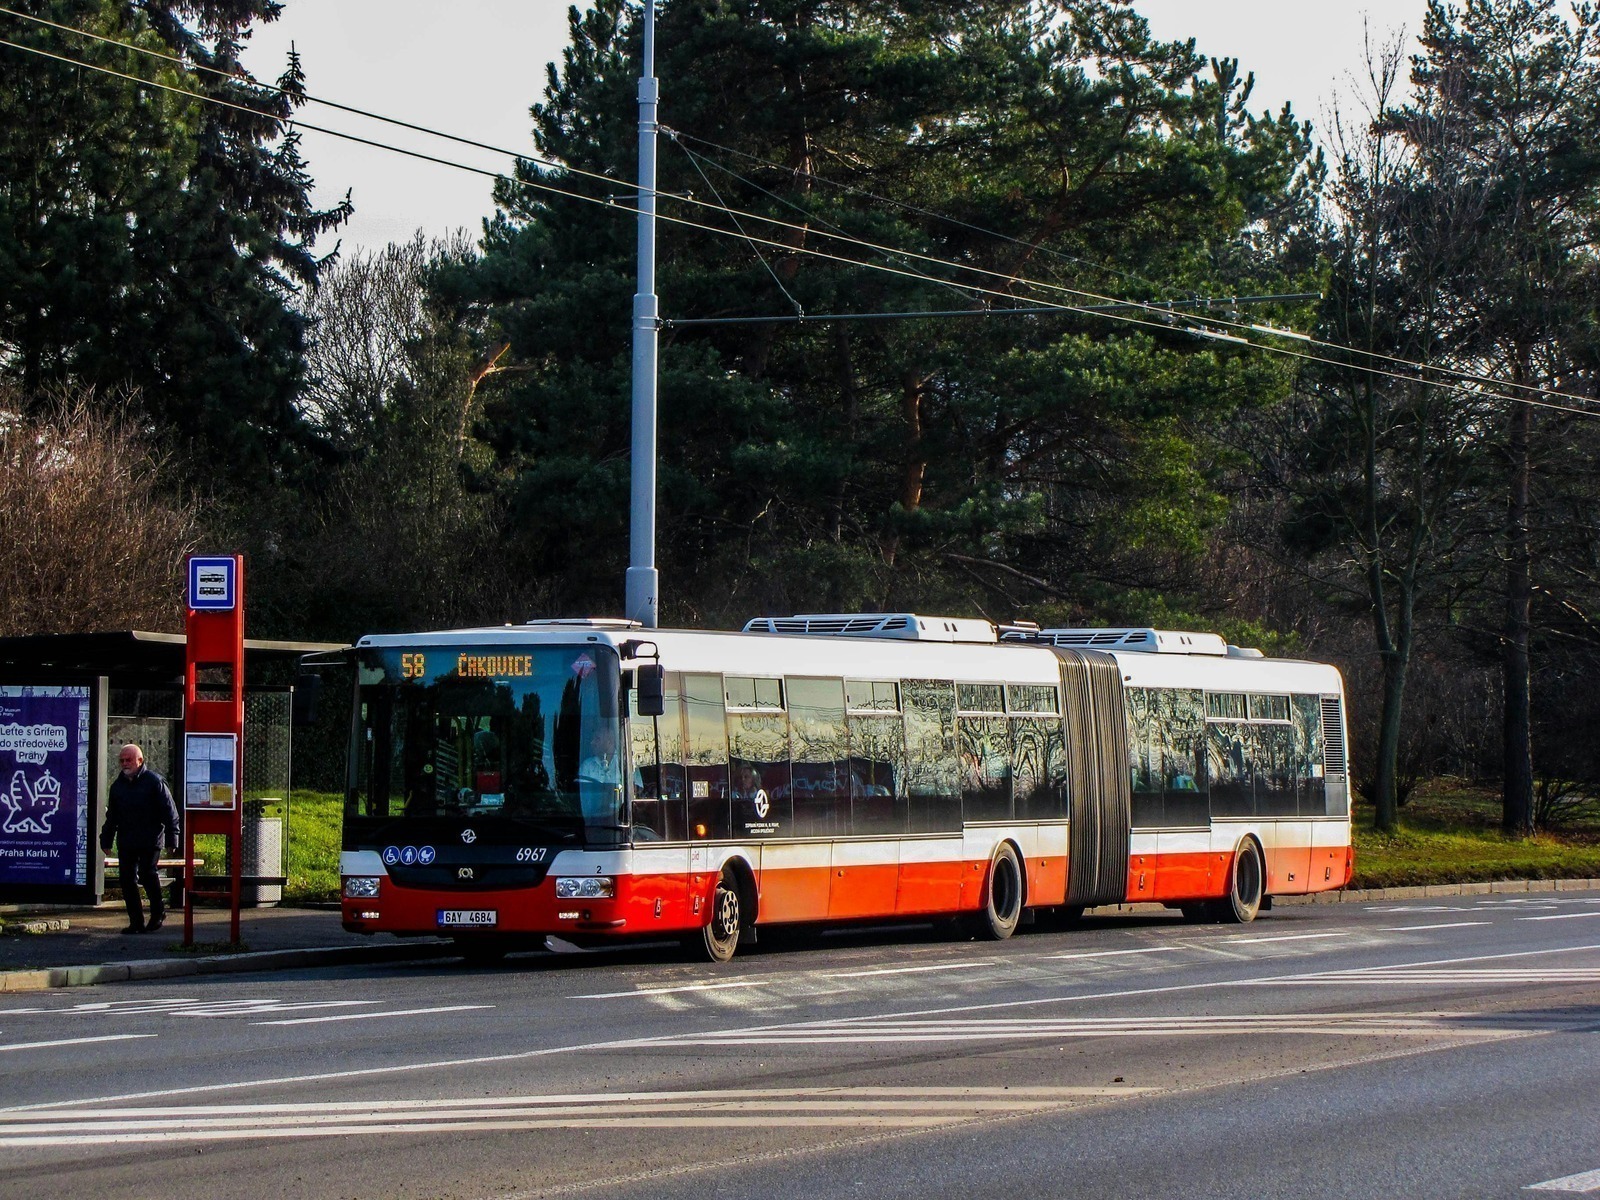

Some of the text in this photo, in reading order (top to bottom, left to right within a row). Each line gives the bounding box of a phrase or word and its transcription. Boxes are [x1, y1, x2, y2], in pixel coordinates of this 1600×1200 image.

[402, 653, 533, 677] 58 ČAKOVICE
[0, 726, 24, 736] Leťte
[34, 727, 64, 736] Grifem
[0, 739, 65, 748] do středověké
[19, 751, 44, 762] Prahy
[693, 782, 707, 797] 6967
[0, 849, 60, 858] Praha Karla IV.
[516, 847, 547, 861] 6967
[596, 865, 602, 874] 2
[445, 912, 492, 923] 6AY 4684
